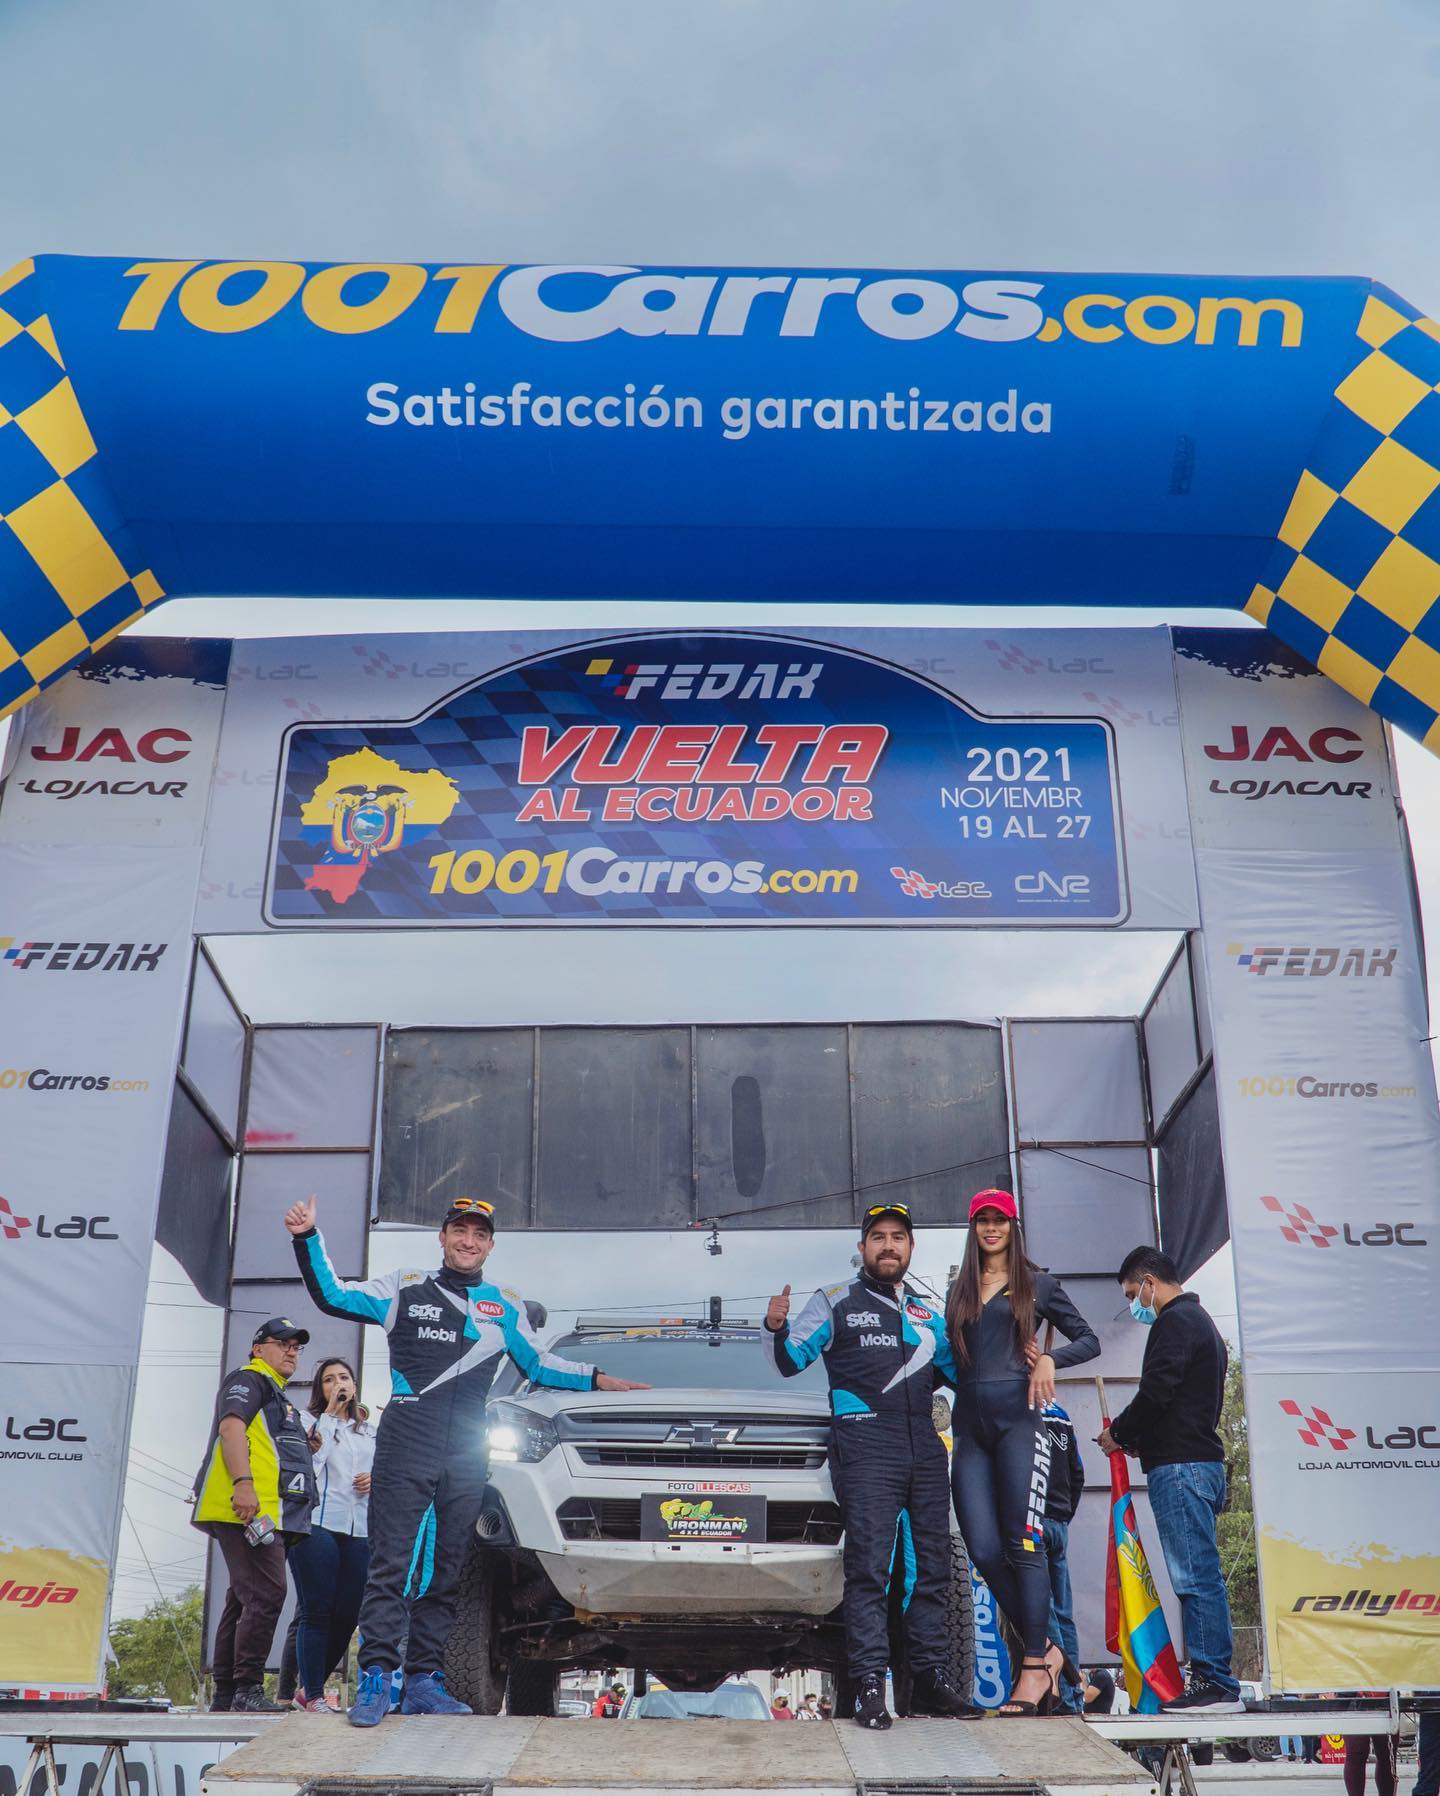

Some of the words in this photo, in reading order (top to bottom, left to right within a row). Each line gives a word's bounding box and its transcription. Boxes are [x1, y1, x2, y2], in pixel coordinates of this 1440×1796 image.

[117, 260, 1304, 347] 1001Carros.com
[365, 382, 703, 428] Satisfacción
[720, 387, 1052, 440] garantizada
[625, 663, 823, 700] FEDAK
[30, 726, 192, 764] JAC
[517, 723, 889, 785] VUELTA
[1203, 725, 1365, 764] JAC
[966, 747, 1071, 782] 2021
[18, 779, 189, 800] LOJACAR
[940, 786, 1083, 809] NOVIEMBR
[1209, 779, 1373, 800] LOJACAR
[516, 787, 592, 823] AL
[601, 786, 873, 823] ECUADOR
[958, 815, 993, 839] 19
[1002, 815, 1046, 839] AL
[1056, 815, 1092, 839] 27
[428, 846, 858, 897] 1001Carros.com
[20, 942, 168, 971] FEDAK
[1256, 947, 1397, 976] FEDAK
[1237, 1075, 1417, 1099] 1001Carros.com
[479, 1302, 502, 1314] WAY
[910, 1305, 929, 1319] WAY
[418, 1326, 457, 1342] Mobil
[860, 1333, 898, 1347] Mobil
[48, 1452, 83, 1461] CLUB
[1298, 1462, 1333, 1470] LOJA
[1335, 1461, 1413, 1470] AUTOMOVIL
[667, 1482, 695, 1490] FOTO
[696, 1482, 751, 1493] ILLESCAS
[1026, 1430, 1051, 1532] FEDAK
[672, 1520, 743, 1530] IRONMAN
